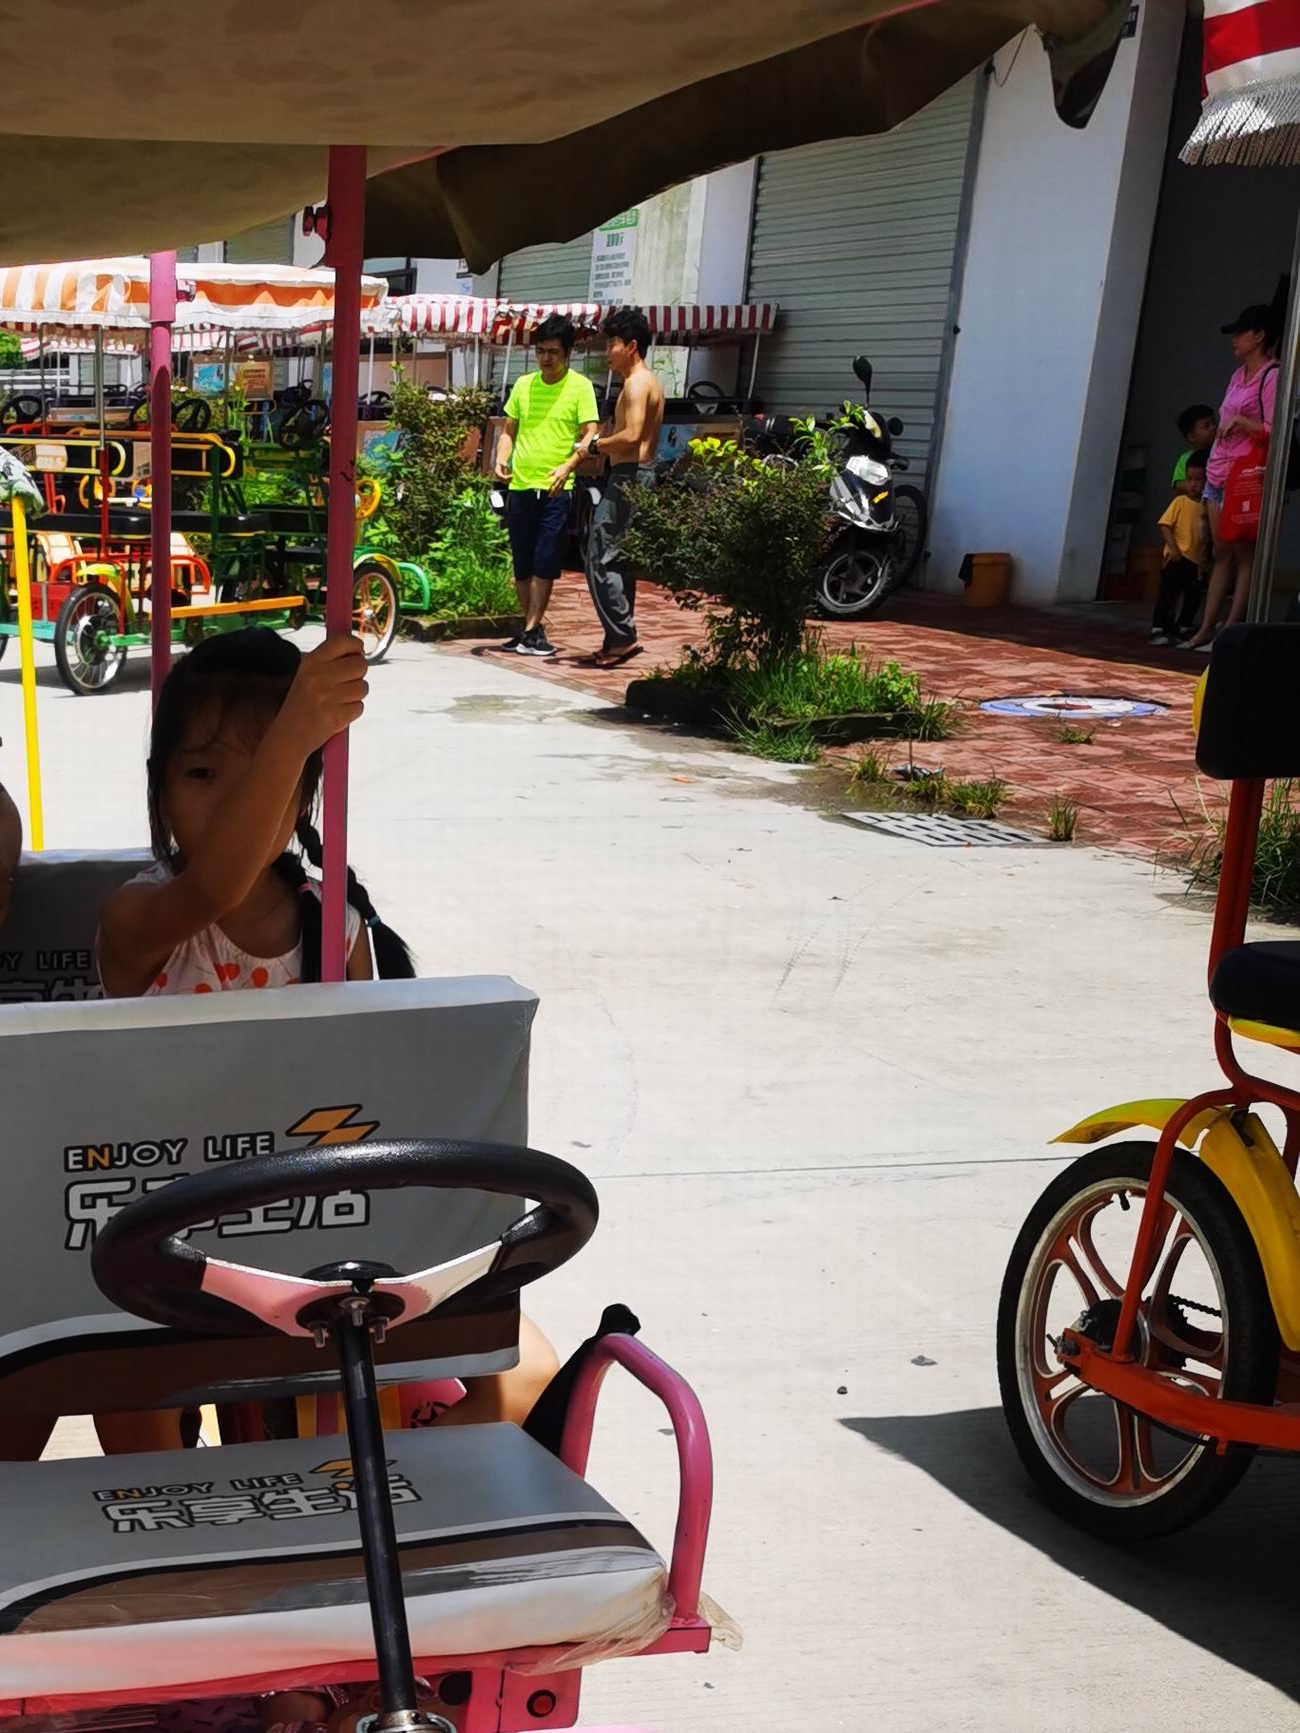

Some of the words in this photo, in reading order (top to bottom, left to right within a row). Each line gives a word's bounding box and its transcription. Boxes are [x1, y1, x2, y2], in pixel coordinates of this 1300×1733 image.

[38, 951, 90, 970] LIFE
[65, 1139, 187, 1172] ENJOY
[204, 1133, 273, 1161] LIFE
[94, 1482, 214, 1502] ENJOY
[230, 1473, 303, 1491] LIFE
